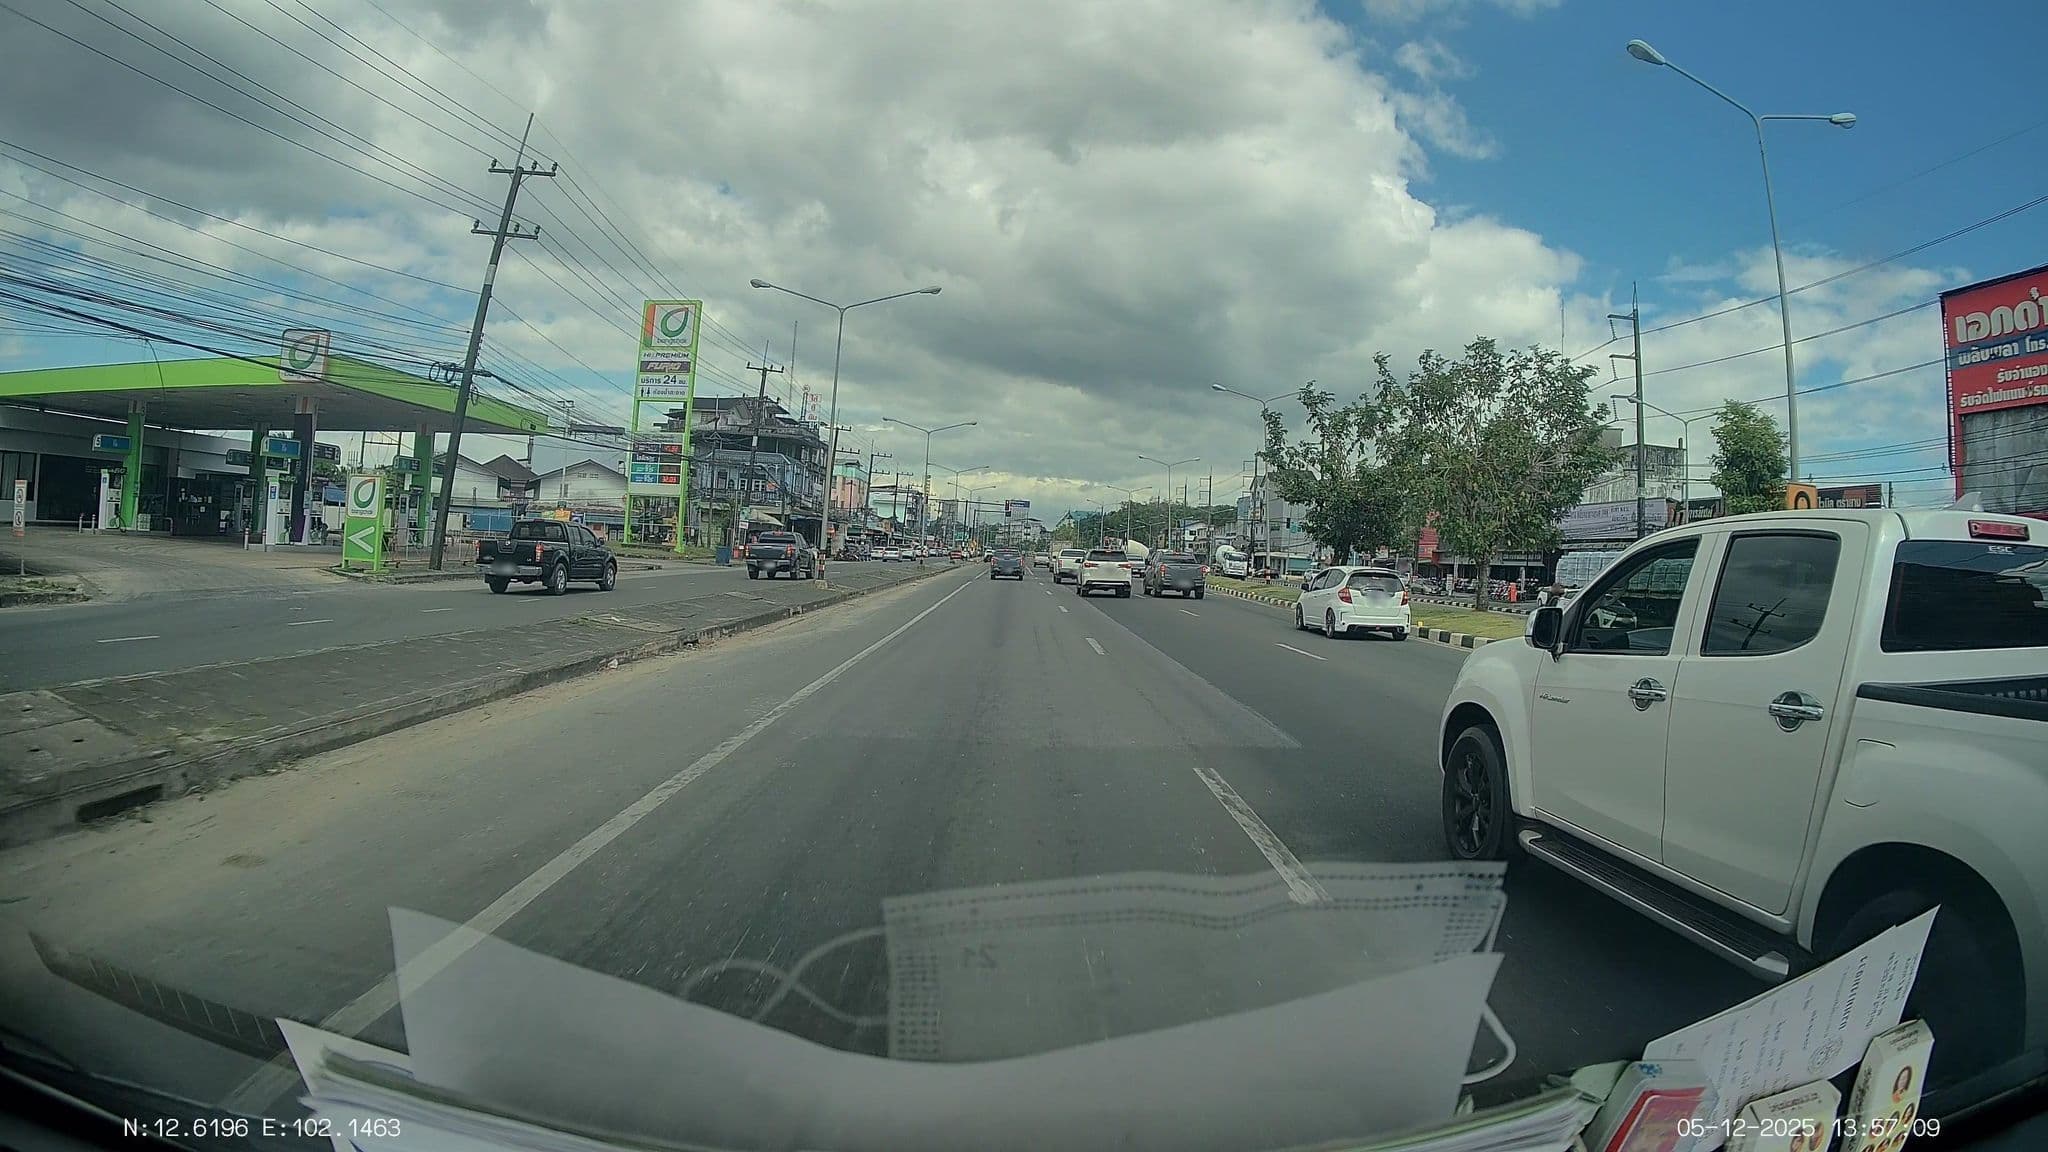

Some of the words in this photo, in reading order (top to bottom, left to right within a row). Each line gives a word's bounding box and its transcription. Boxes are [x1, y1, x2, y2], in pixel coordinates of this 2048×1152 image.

[640, 376, 662, 385] บริการ
[662, 374, 678, 385] 24
